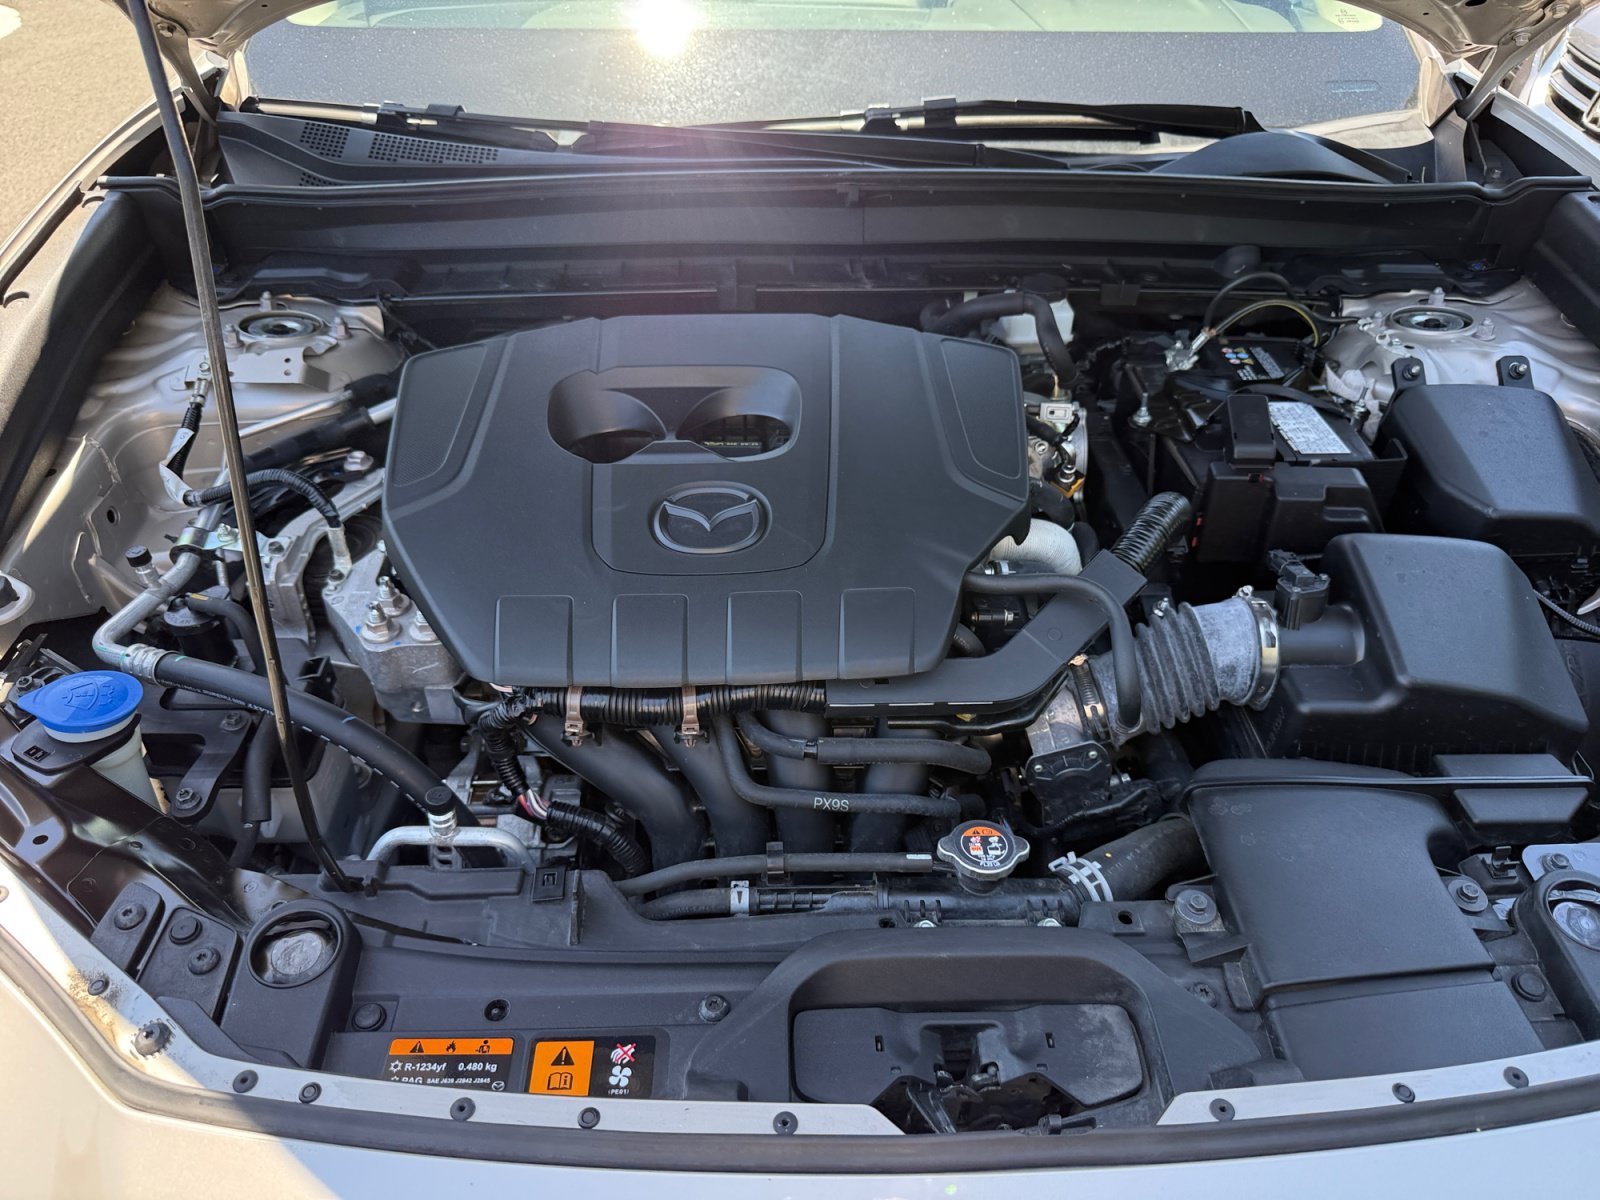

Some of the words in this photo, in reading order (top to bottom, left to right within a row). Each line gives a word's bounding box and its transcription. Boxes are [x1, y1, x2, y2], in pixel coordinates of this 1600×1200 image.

[813, 796, 850, 812] PX9S
[404, 1062, 446, 1072] R-1234yf
[458, 1062, 483, 1071] 0.480
[485, 1062, 497, 1072] kg
